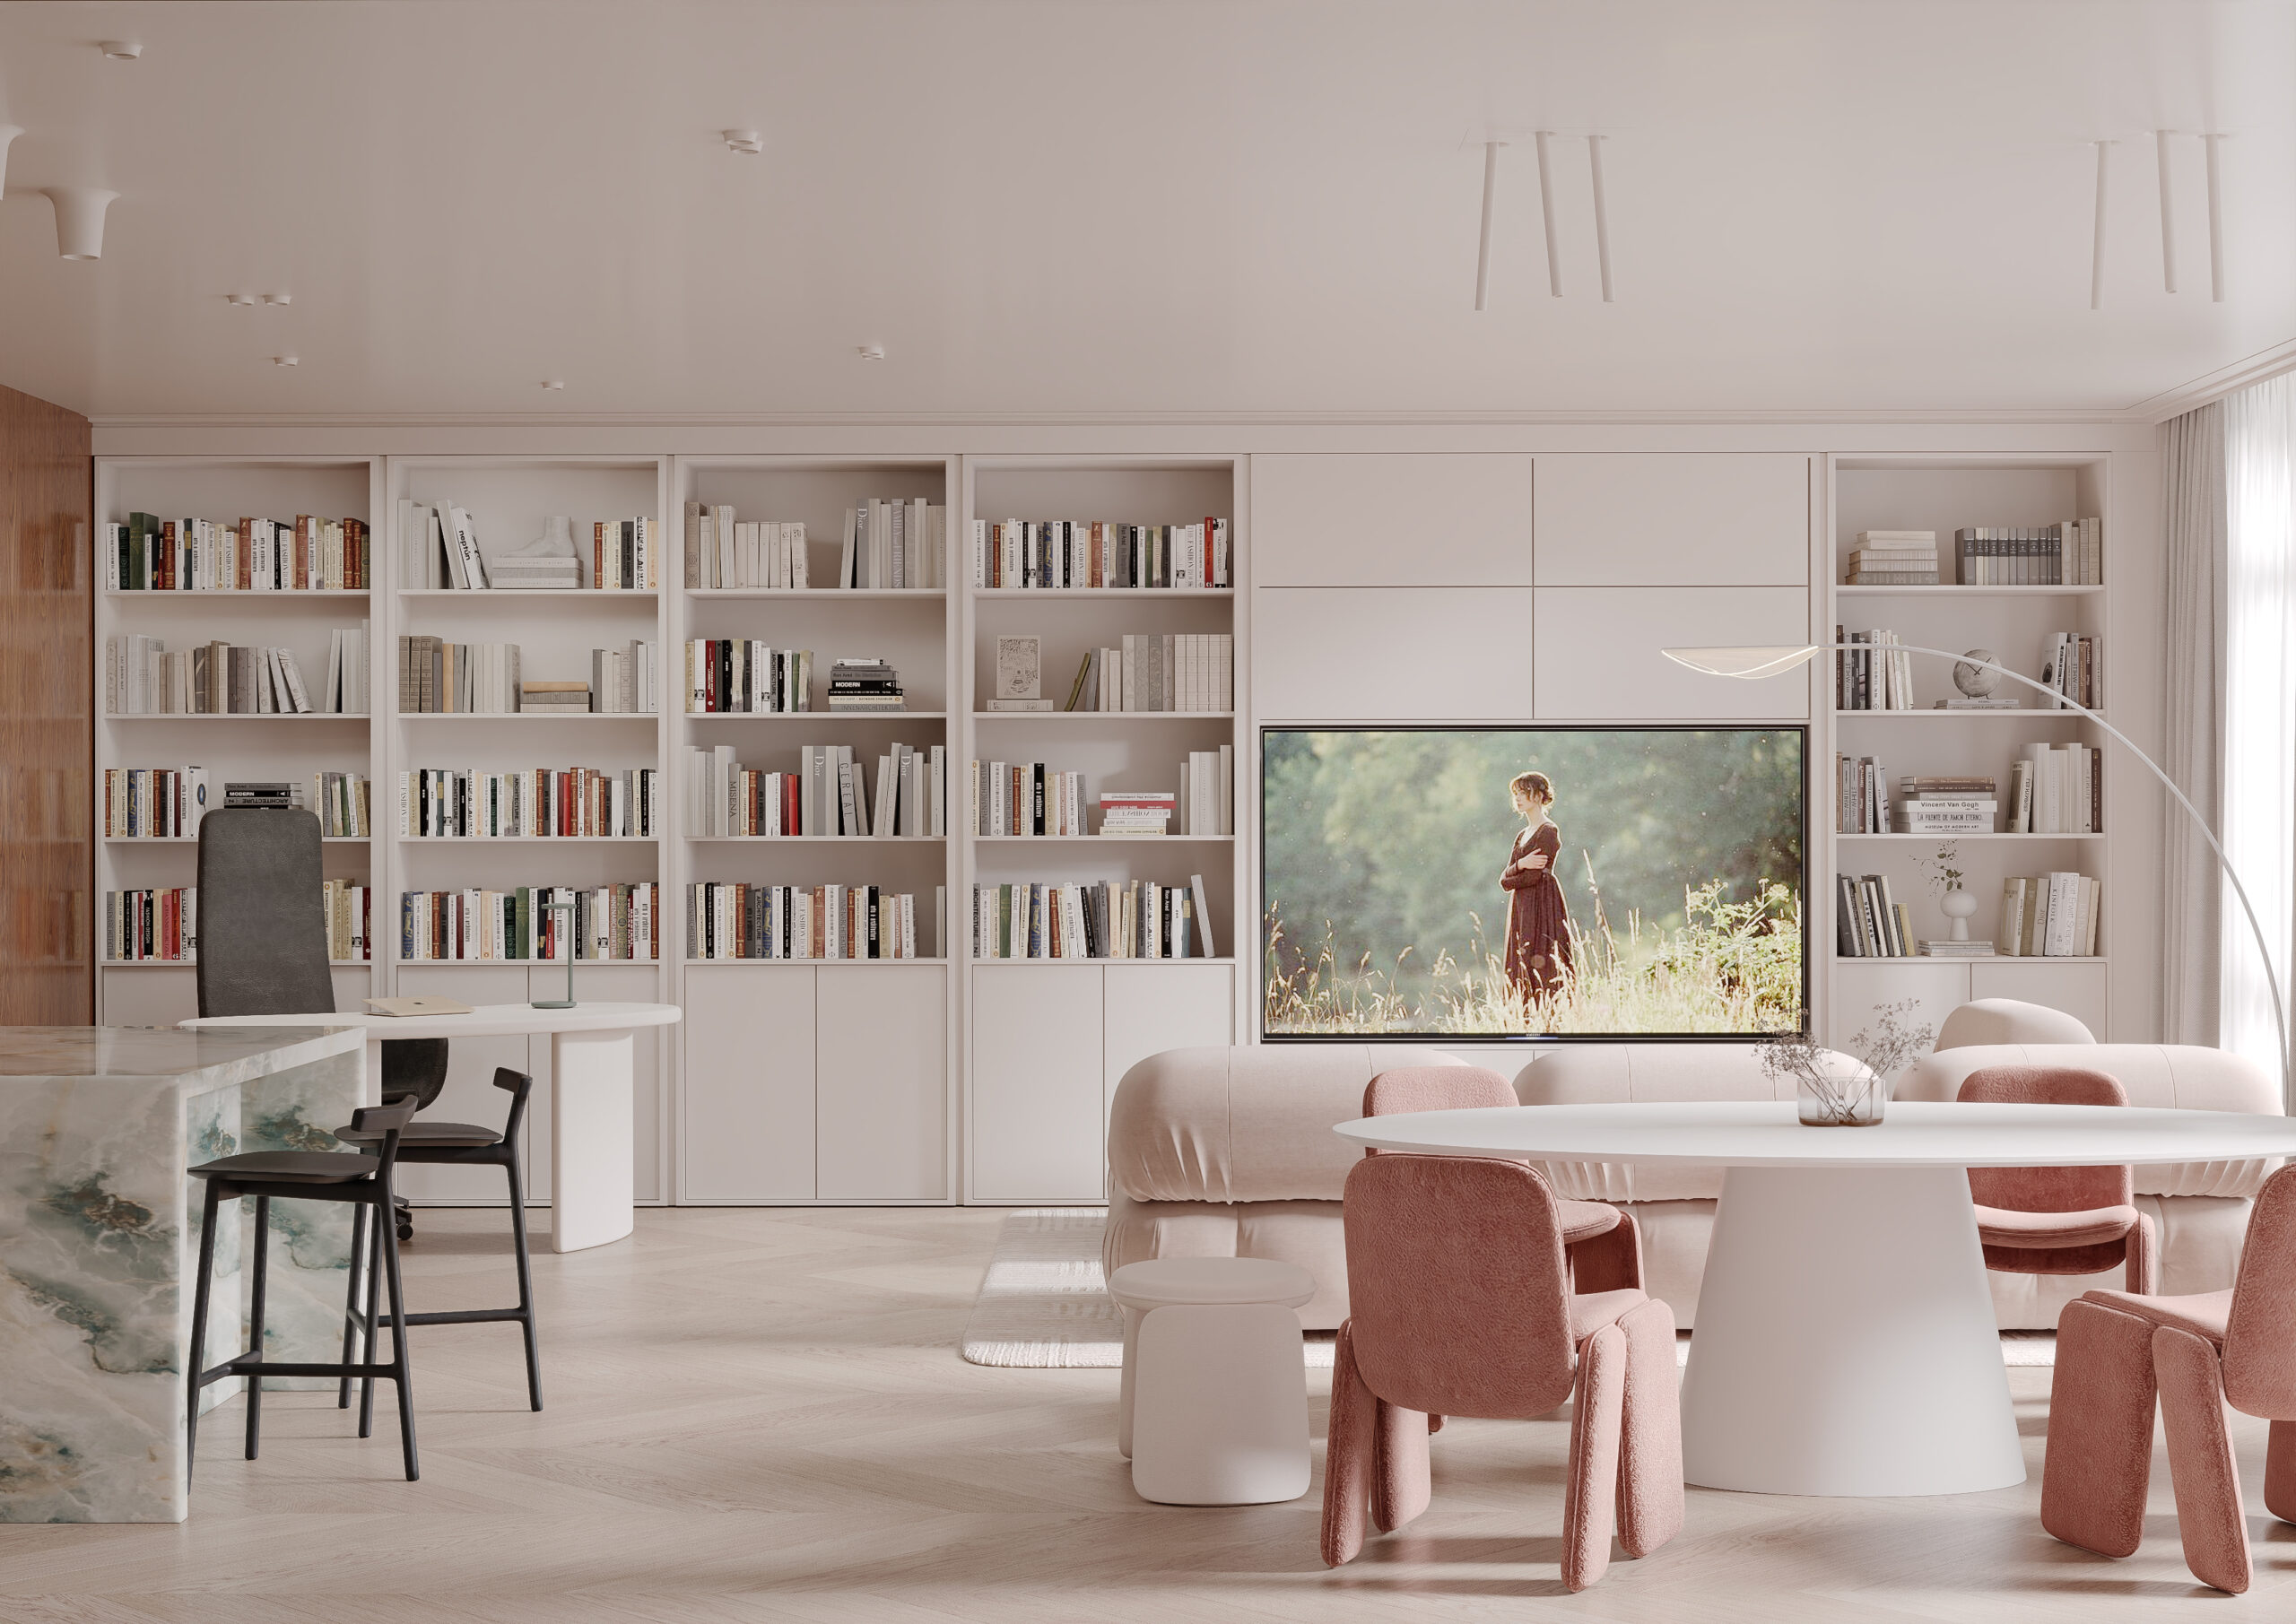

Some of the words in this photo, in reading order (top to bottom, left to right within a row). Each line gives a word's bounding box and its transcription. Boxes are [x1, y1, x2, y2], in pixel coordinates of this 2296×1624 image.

[857, 508, 868, 529] Dior
[892, 502, 903, 537] FAMILY
[892, 545, 903, 588] FRIENDS
[814, 756, 825, 777] Dior
[900, 756, 911, 777] Dior
[839, 762, 854, 816] CEREAL
[1918, 813, 1923, 821] LA
[2038, 909, 2047, 925] Dior
